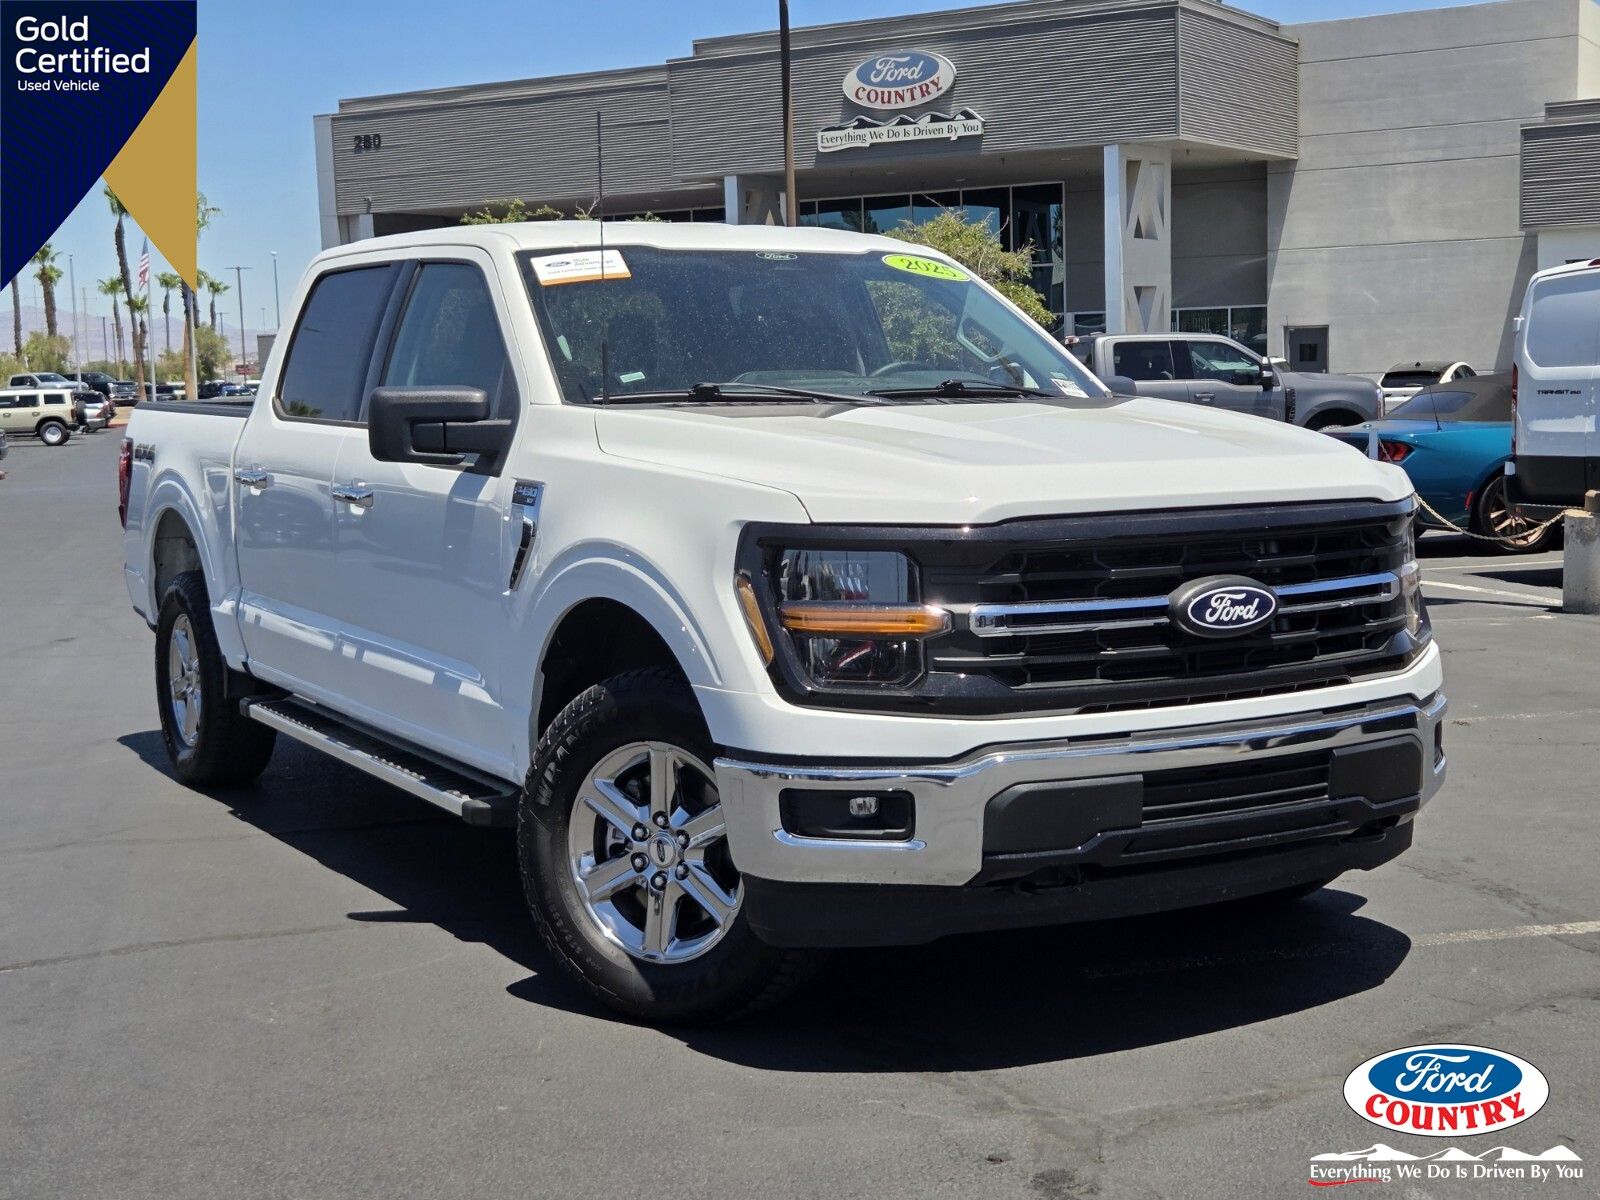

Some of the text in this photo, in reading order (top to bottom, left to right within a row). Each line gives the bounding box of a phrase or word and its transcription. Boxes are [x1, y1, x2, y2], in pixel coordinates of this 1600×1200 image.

[870, 56, 925, 83] Ford
[854, 76, 943, 105] COUNTRY
[820, 122, 979, 145] Everything We Do Is Driven By You
[900, 258, 957, 277] 2025
[1205, 593, 1260, 623] Ford
